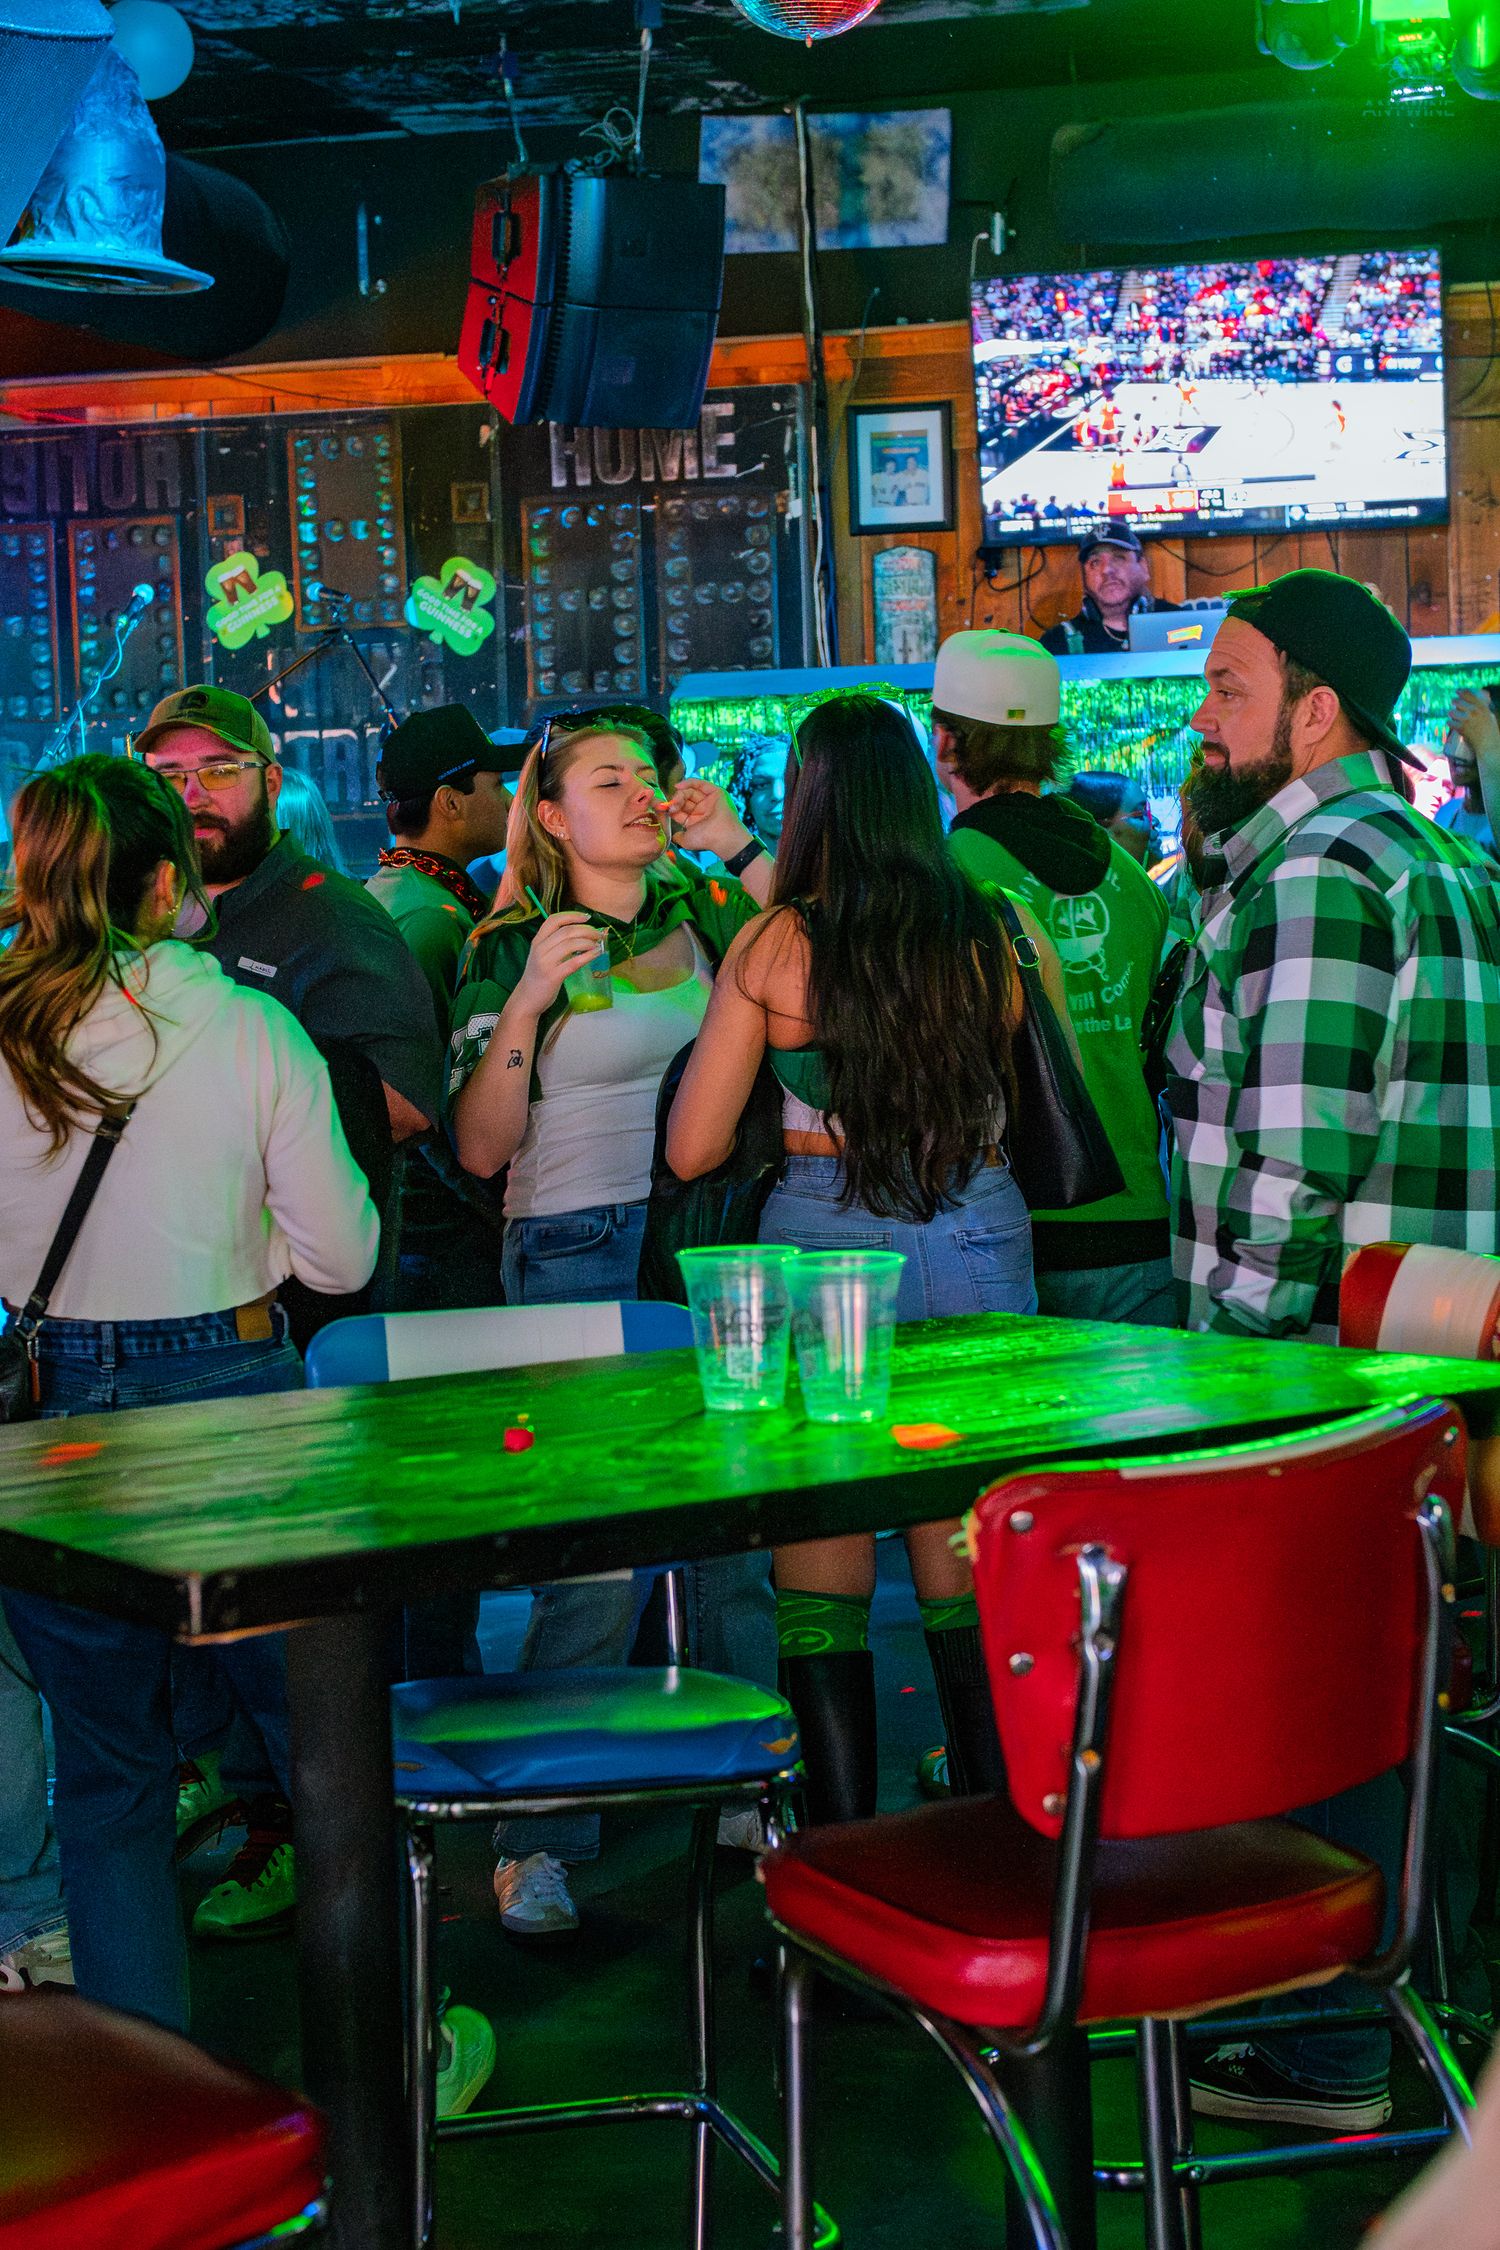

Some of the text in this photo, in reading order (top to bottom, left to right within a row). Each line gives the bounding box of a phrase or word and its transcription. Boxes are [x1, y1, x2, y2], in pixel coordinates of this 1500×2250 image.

[549, 402, 738, 488] HOME
[227, 596, 279, 633] GUINNESS
[417, 588, 442, 607] GOOD
[442, 603, 461, 619] TIME
[419, 601, 472, 639] GUINNESS
